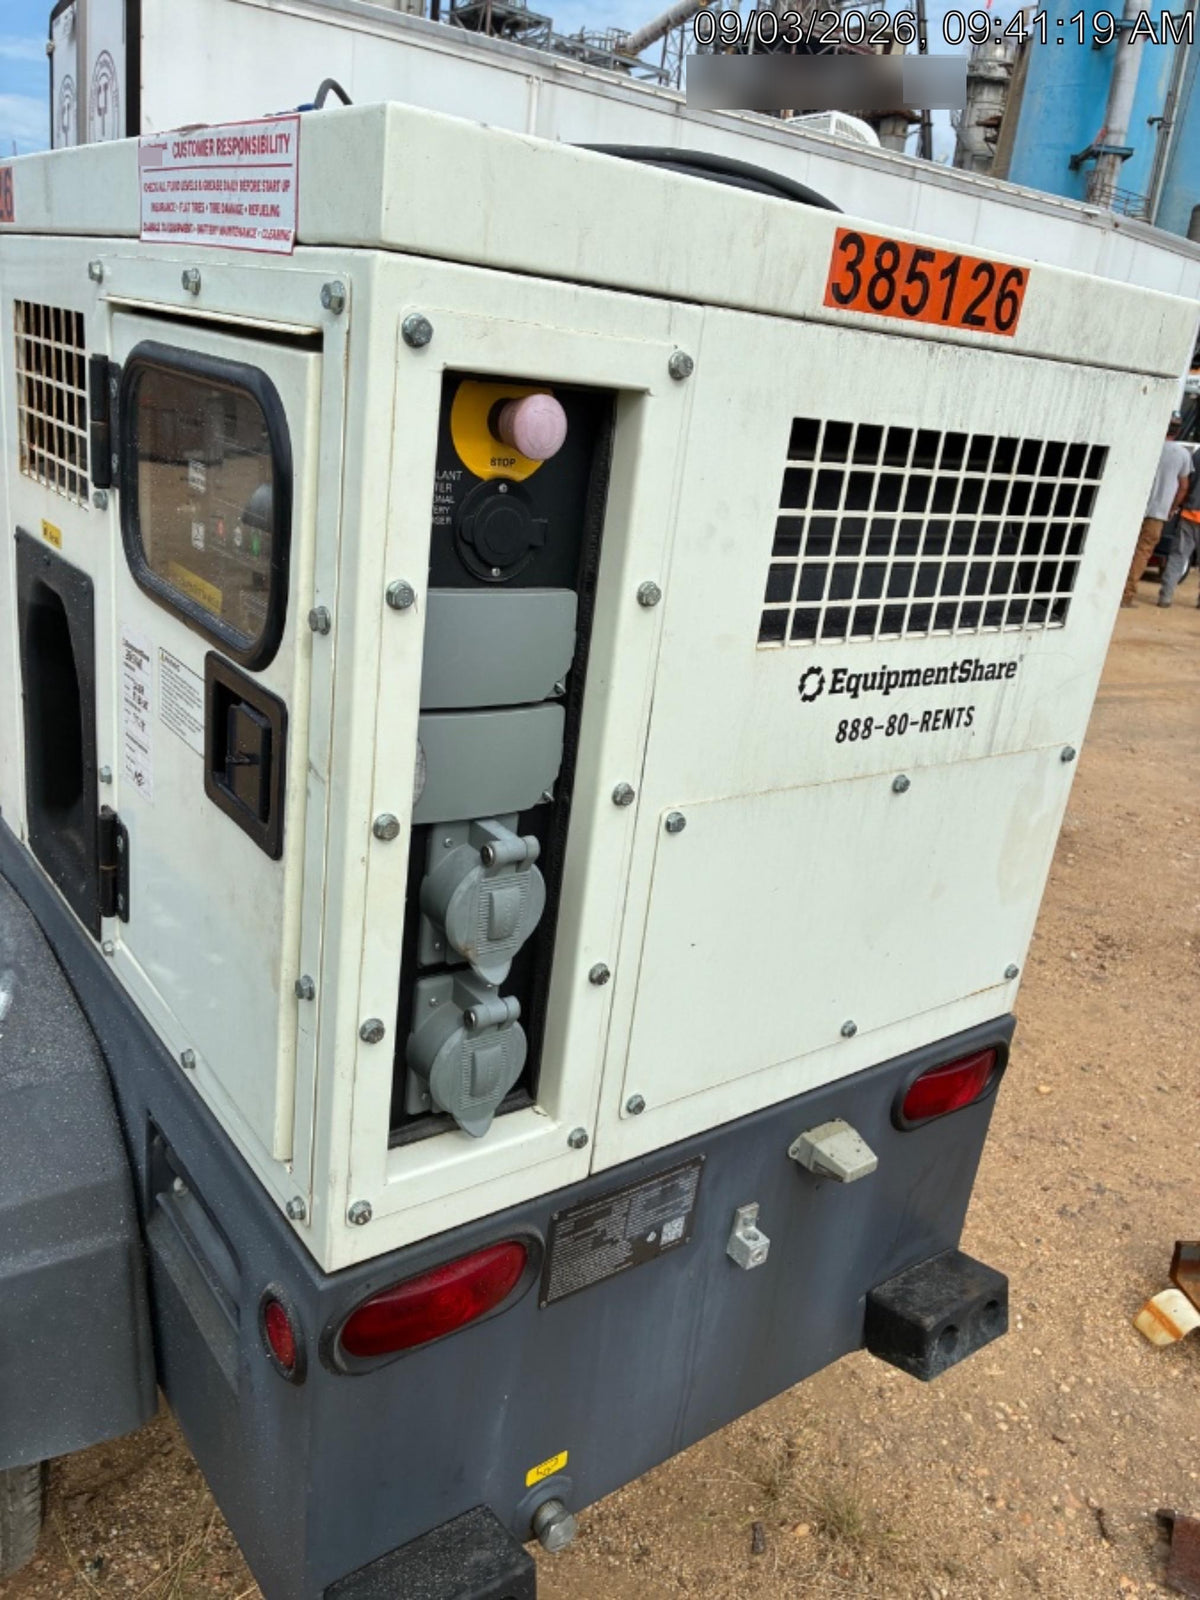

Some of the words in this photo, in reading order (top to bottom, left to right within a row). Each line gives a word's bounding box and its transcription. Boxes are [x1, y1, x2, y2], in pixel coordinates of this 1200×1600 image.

[172, 139, 214, 158] CUSTOMER
[216, 133, 290, 156] RESPONSIBILITY
[240, 179, 260, 193] BEFORE
[831, 232, 1023, 331] 385126
[490, 457, 516, 467] STOP
[437, 470, 463, 481] LANT
[828, 658, 1018, 699] EquipmentShare
[835, 705, 975, 743] 888-80-RENTS
